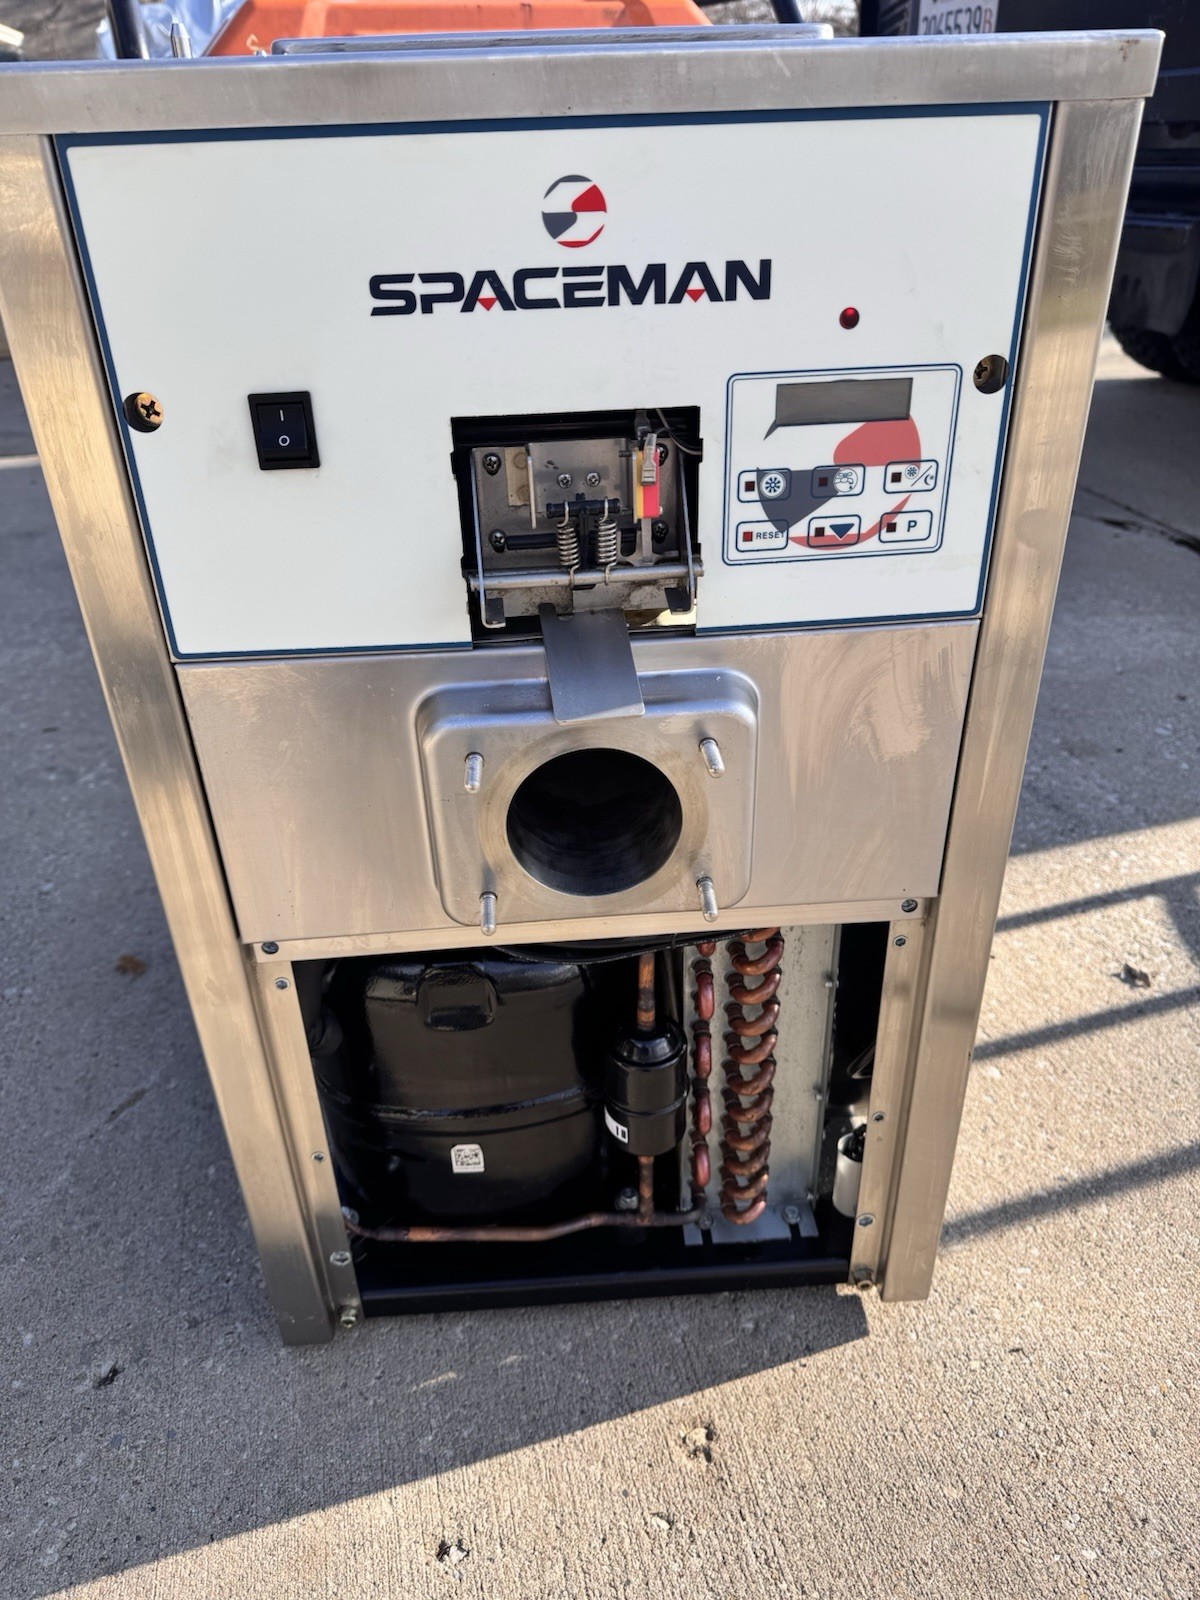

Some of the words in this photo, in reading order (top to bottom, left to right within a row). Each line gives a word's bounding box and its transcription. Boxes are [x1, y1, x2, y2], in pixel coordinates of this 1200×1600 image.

[369, 258, 772, 317] SPACEMAN
[906, 519, 918, 533] P
[755, 530, 786, 540] RESET
